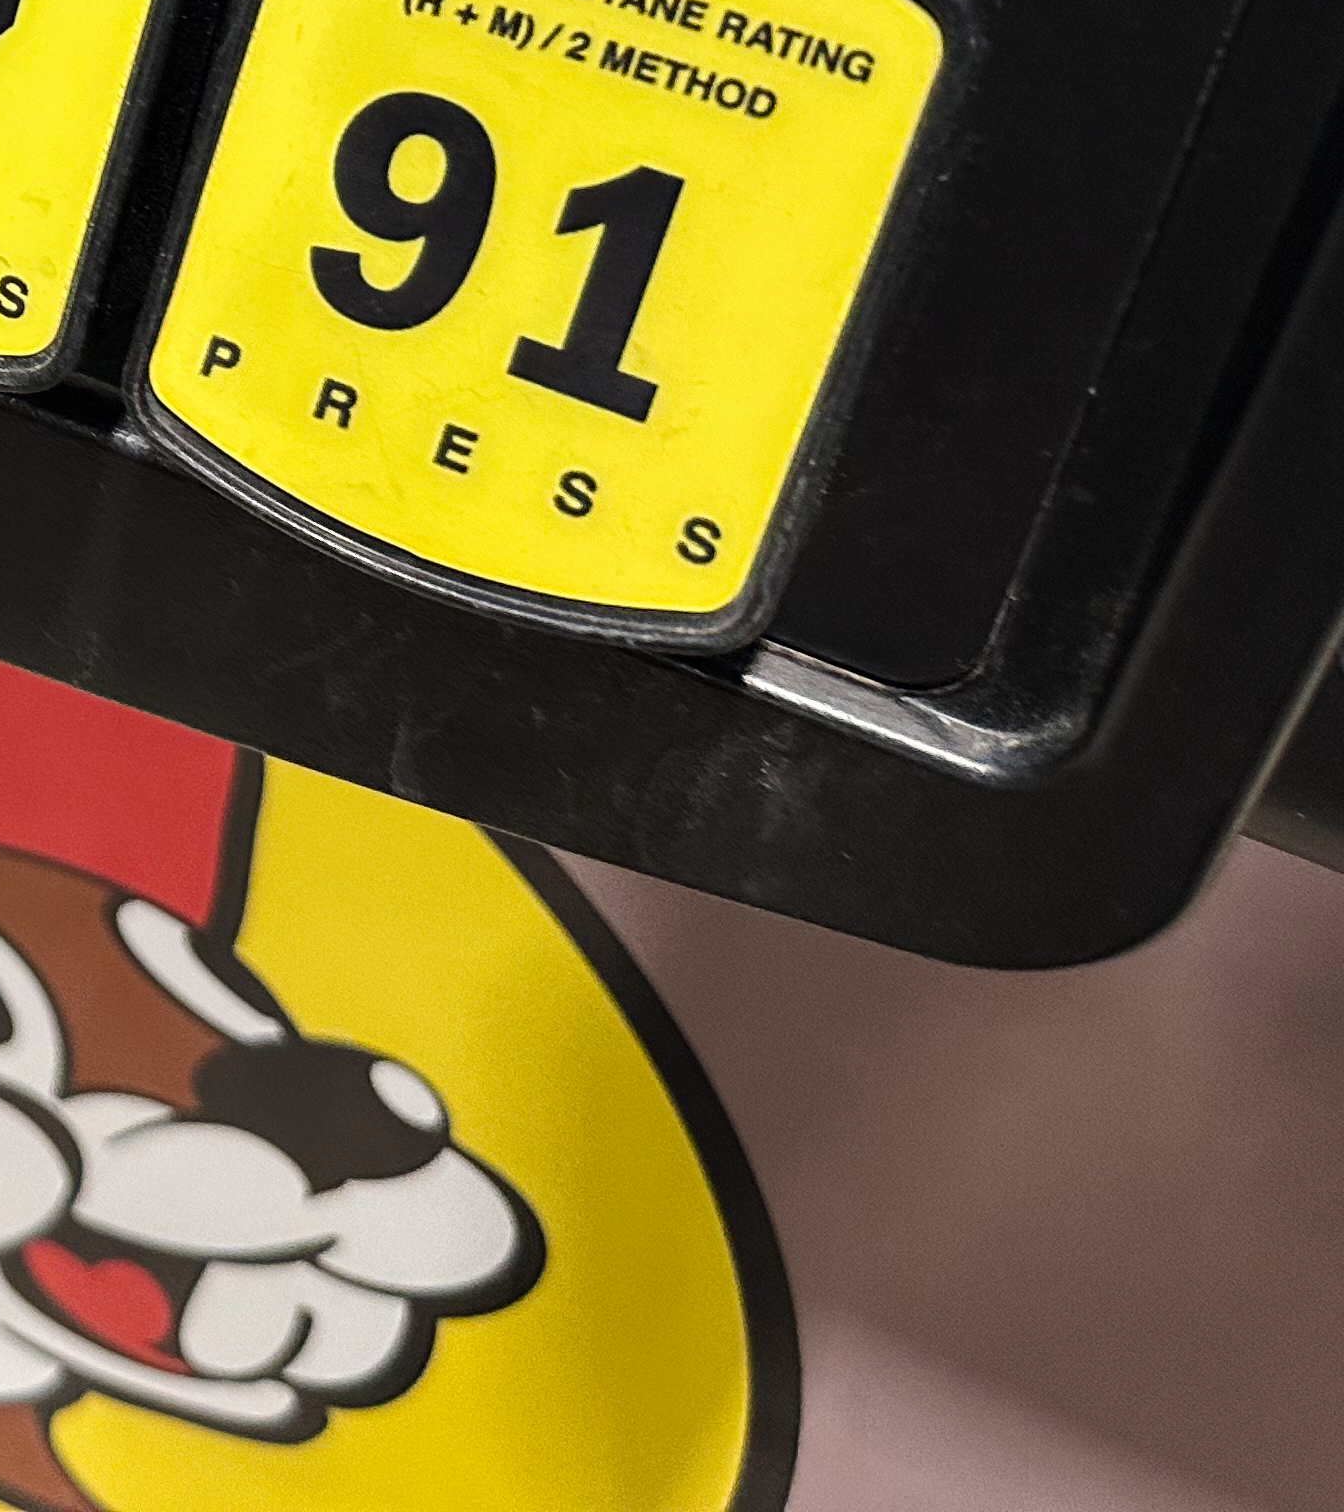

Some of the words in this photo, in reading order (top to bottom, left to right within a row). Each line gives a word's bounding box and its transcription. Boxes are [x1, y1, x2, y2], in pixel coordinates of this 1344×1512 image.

[488, 5, 537, 52] M)
[565, 31, 593, 63] 2
[598, 40, 778, 121] METHOD
[716, 9, 877, 85] RATING
[309, 89, 686, 426] 91
